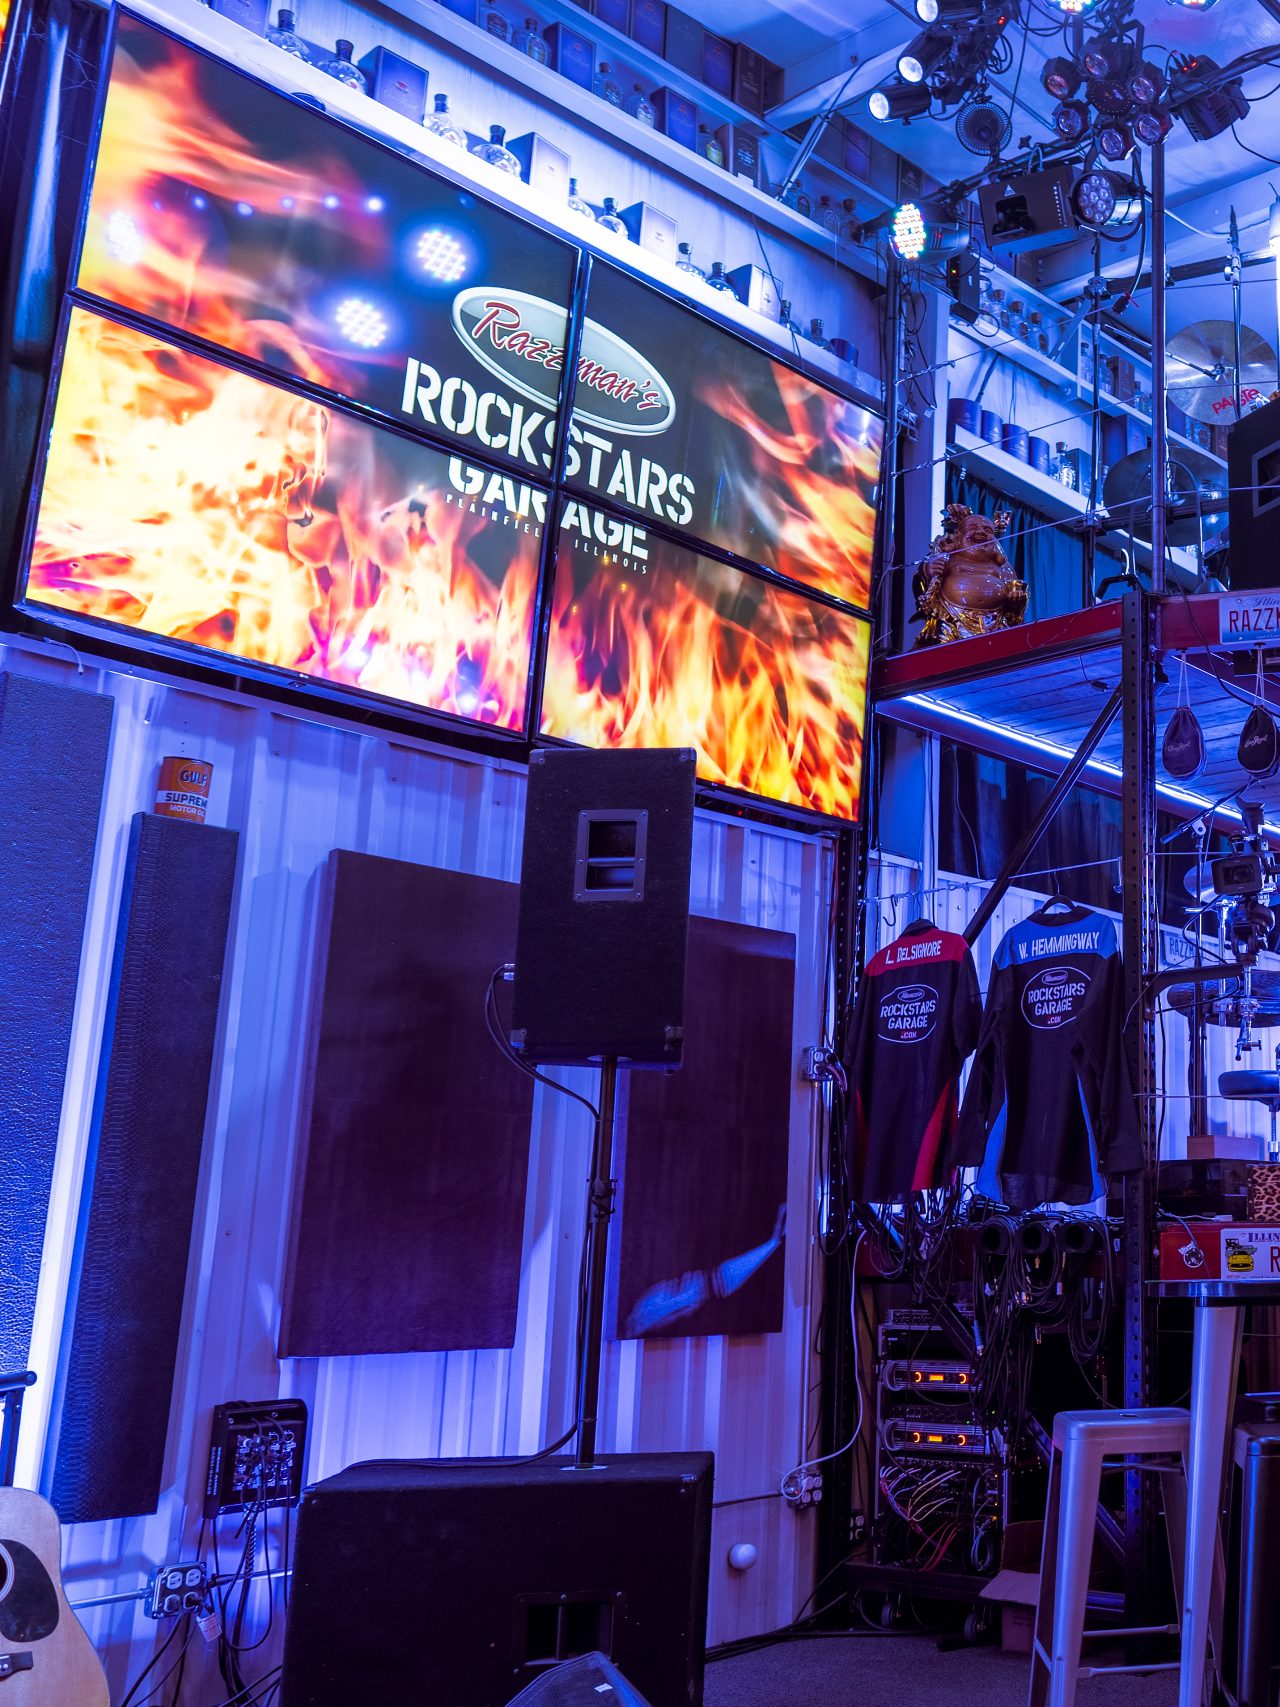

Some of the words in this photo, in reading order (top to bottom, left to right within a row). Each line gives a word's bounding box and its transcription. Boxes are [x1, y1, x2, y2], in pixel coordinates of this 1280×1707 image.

[472, 301, 662, 411] Razzman's
[401, 356, 696, 526] ROCKSTARS
[447, 456, 649, 560] GARAGE
[446, 493, 541, 539] PLAINFIEL
[574, 538, 649, 575] ILLINOIS
[170, 805, 197, 815] MOTOR
[1019, 942, 1028, 960] W.
[1031, 932, 1100, 957] HEMMINGWAY
[1028, 983, 1086, 1003] ROCKSTARS
[880, 1000, 936, 1018] ROCKSTARS
[1035, 998, 1073, 1016] GARAGE
[888, 1015, 928, 1029] GARAGE
